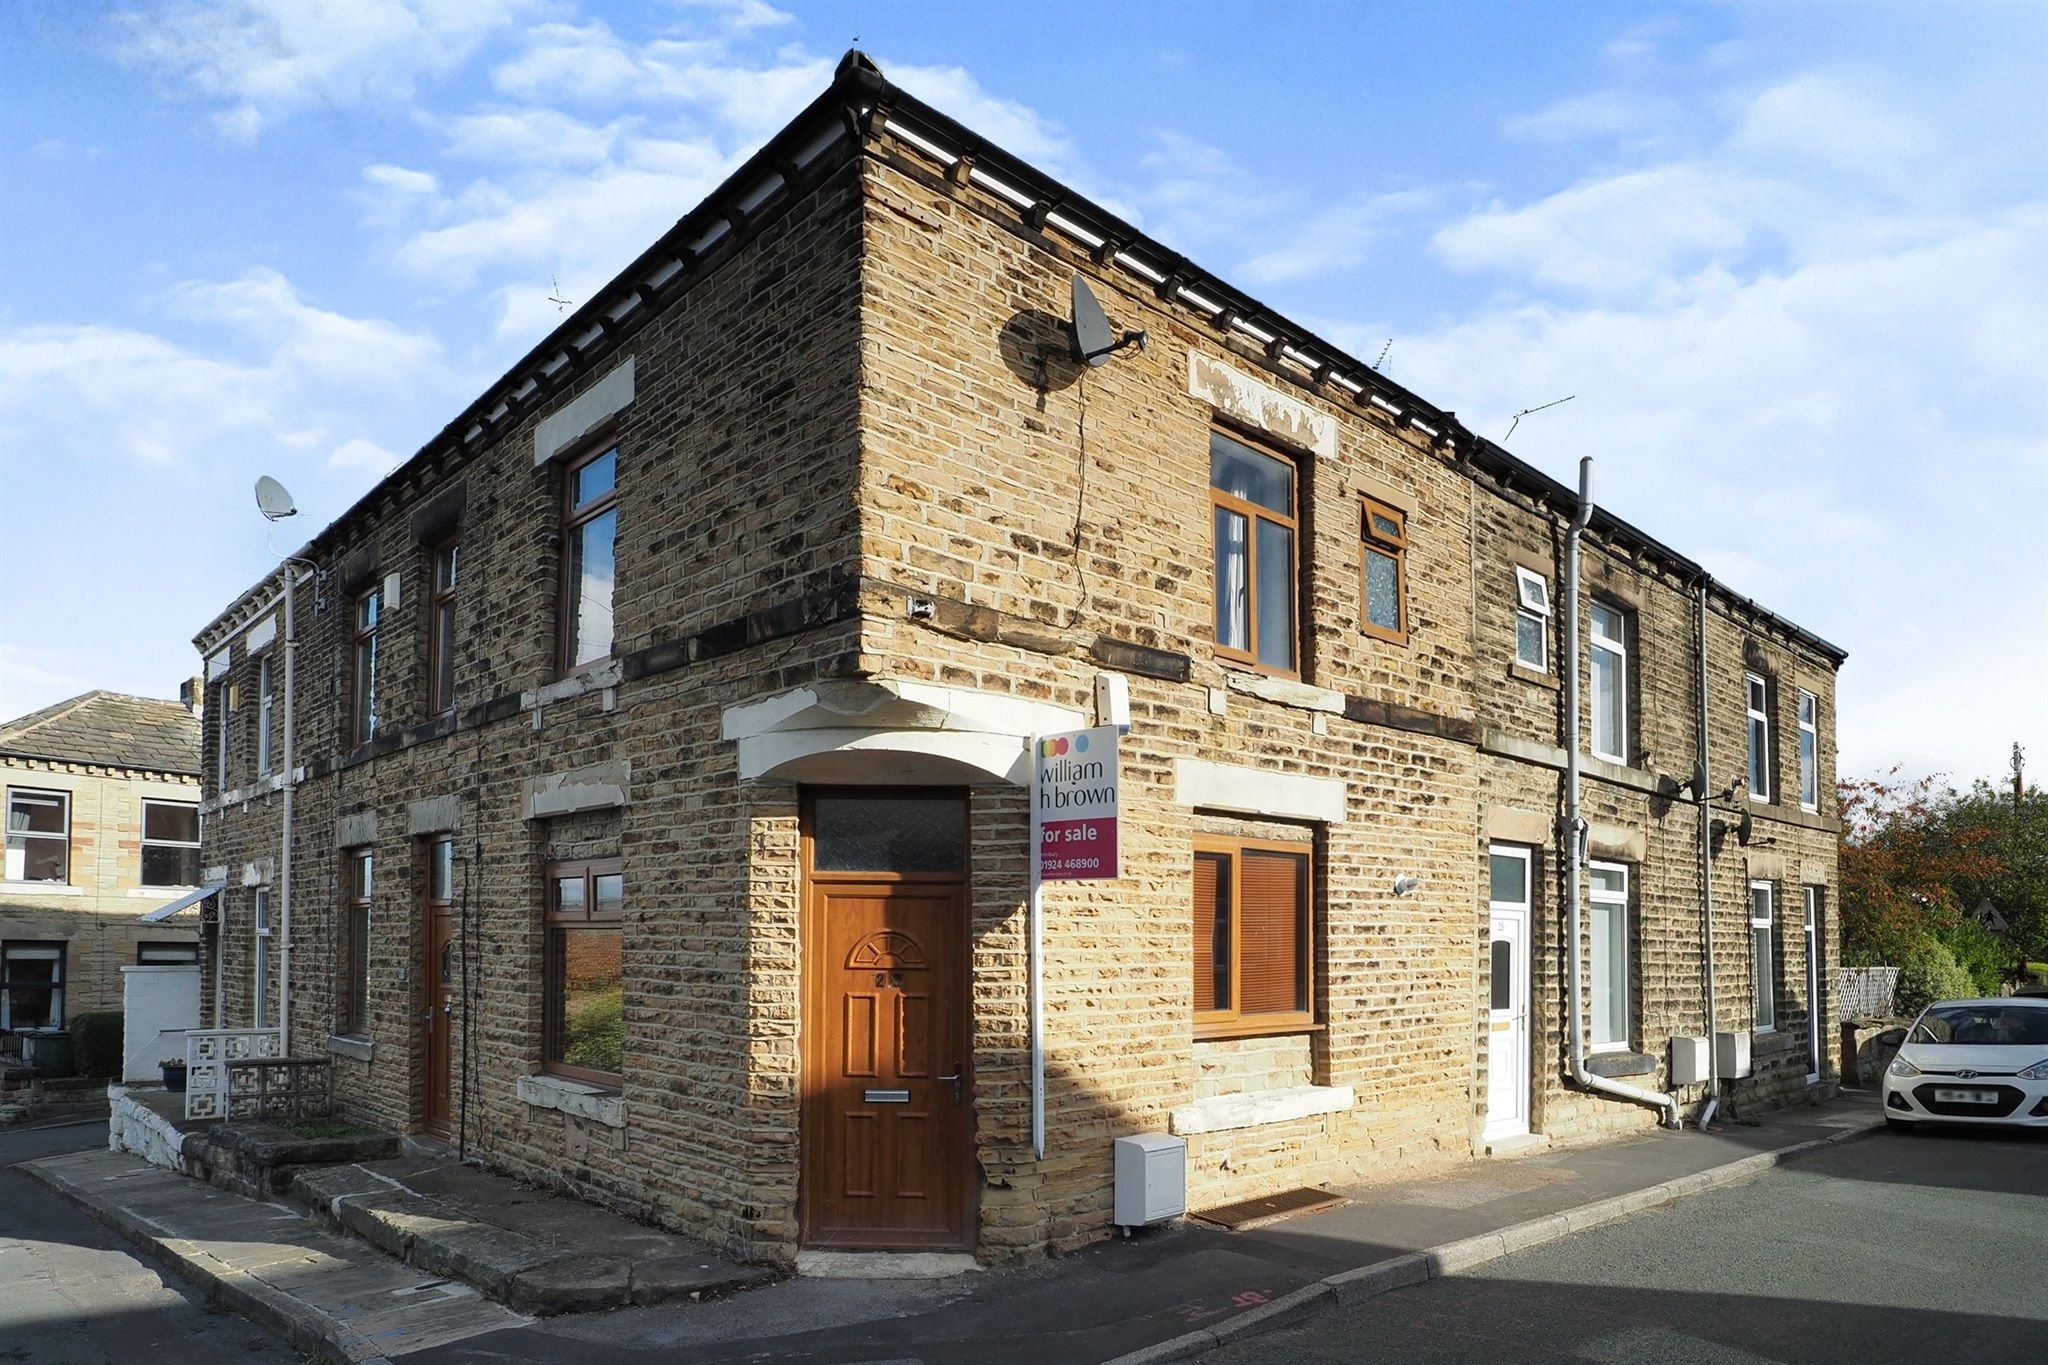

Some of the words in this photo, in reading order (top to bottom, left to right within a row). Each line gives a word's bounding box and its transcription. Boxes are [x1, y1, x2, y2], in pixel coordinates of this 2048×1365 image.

[1041, 759, 1102, 783] william
[1041, 786, 1050, 809] h
[1055, 786, 1115, 809] brown
[1041, 826, 1061, 843] for
[1065, 823, 1097, 841] sale
[1065, 858, 1099, 869] 468900
